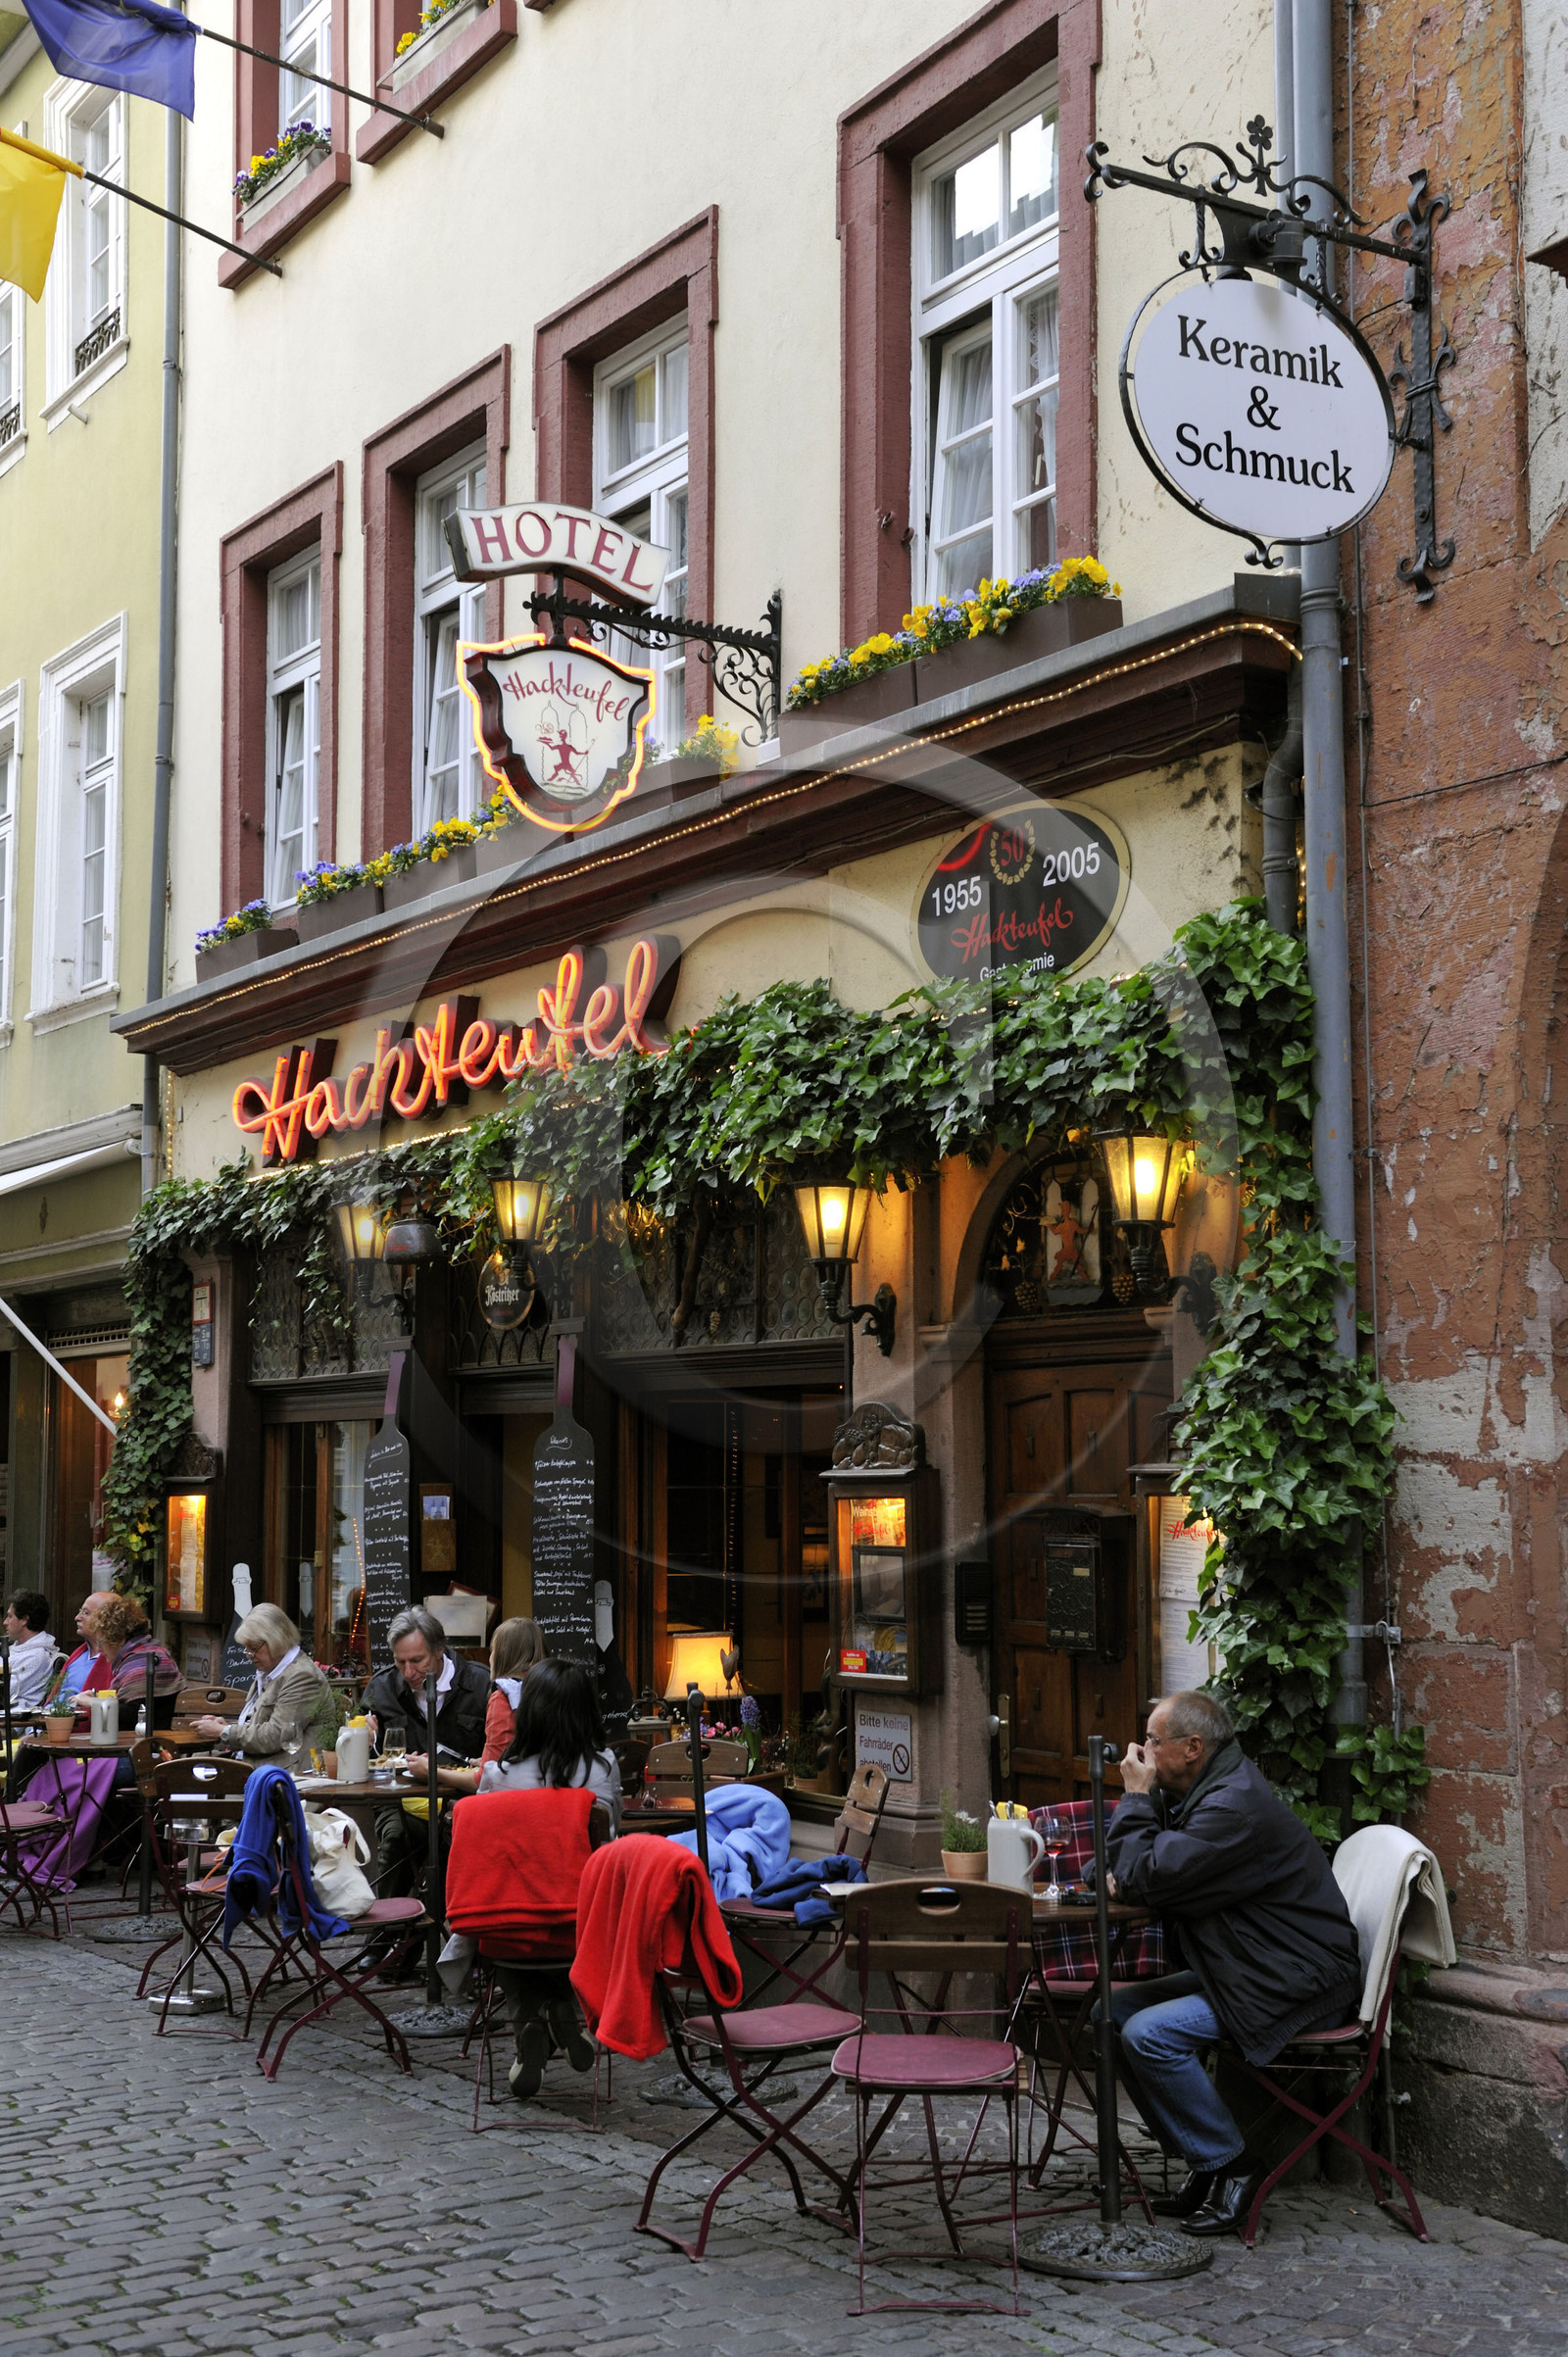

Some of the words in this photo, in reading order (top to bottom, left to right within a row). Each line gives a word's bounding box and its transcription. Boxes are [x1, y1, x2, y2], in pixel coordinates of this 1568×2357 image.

[1178, 315, 1344, 389] Keramik
[1247, 385, 1281, 430] &
[1175, 422, 1355, 494] Schmuck
[469, 511, 654, 591] HOTEL
[502, 662, 630, 723] Hackteufel
[1000, 825, 1024, 867] 50
[1042, 841, 1101, 887] 2005
[932, 876, 982, 916] 1955
[950, 897, 1073, 964] Hackteufel
[231, 938, 670, 1158] Hackteufel
[859, 1714, 881, 1728] Bitte
[883, 1716, 908, 1731] keine
[859, 1736, 894, 1751] Fahrräder
